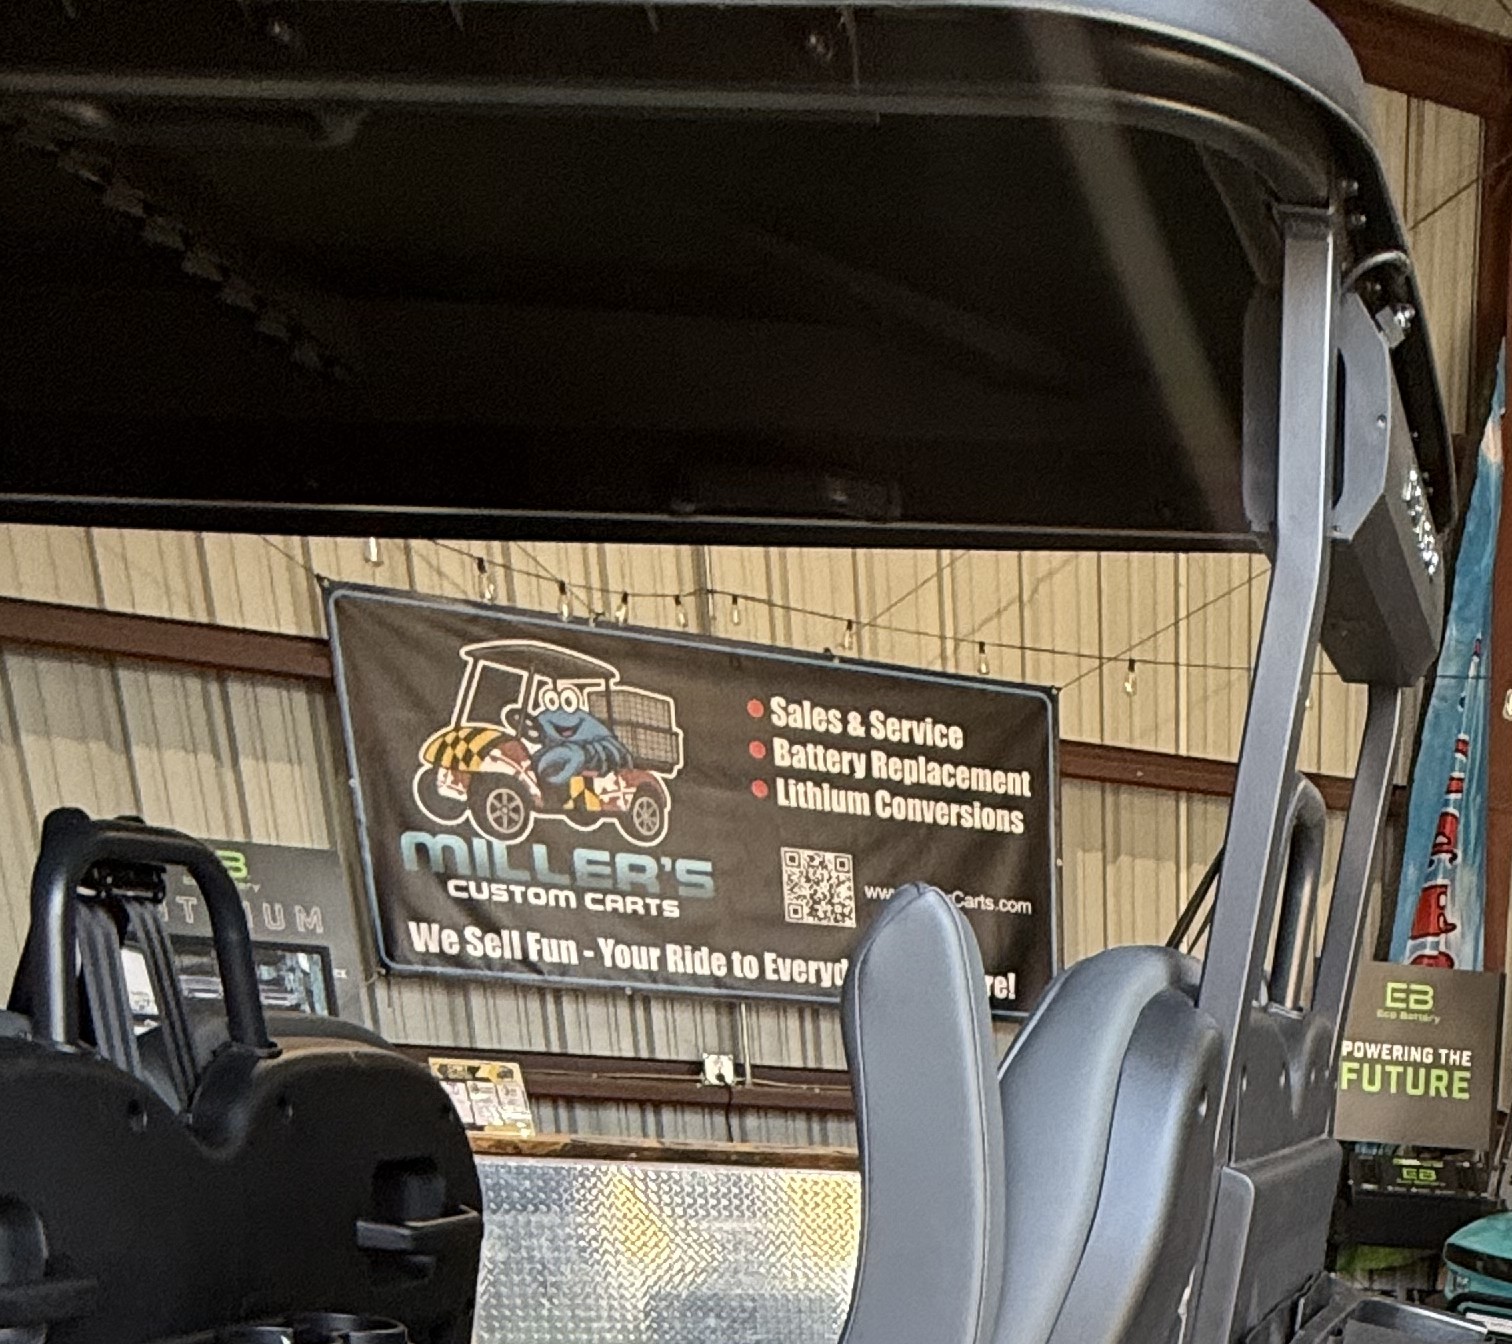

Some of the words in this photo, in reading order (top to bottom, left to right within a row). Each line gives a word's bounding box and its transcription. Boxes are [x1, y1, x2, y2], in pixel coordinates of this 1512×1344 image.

[770, 696, 842, 734] Sales
[847, 710, 866, 738] &
[869, 710, 964, 751] Service
[772, 736, 867, 780] Battery
[870, 749, 1032, 797] Replacement
[776, 777, 871, 816] Lithium
[875, 789, 1025, 835] Conversions
[400, 830, 716, 898] MILLER'S
[447, 878, 577, 909] CUSTOM
[584, 891, 681, 918] CARTS
[408, 920, 460, 955] We
[463, 925, 522, 960] Sell
[526, 930, 580, 965] Fun
[597, 937, 661, 971] Your
[666, 943, 728, 977] Ride
[731, 950, 759, 979] to
[763, 952, 849, 987] Everyd
[1386, 982, 1434, 1010] EB
[1340, 1061, 1472, 1099] FUTURE
[1341, 1040, 1434, 1064] POWERING
[1439, 1048, 1472, 1068] THE
